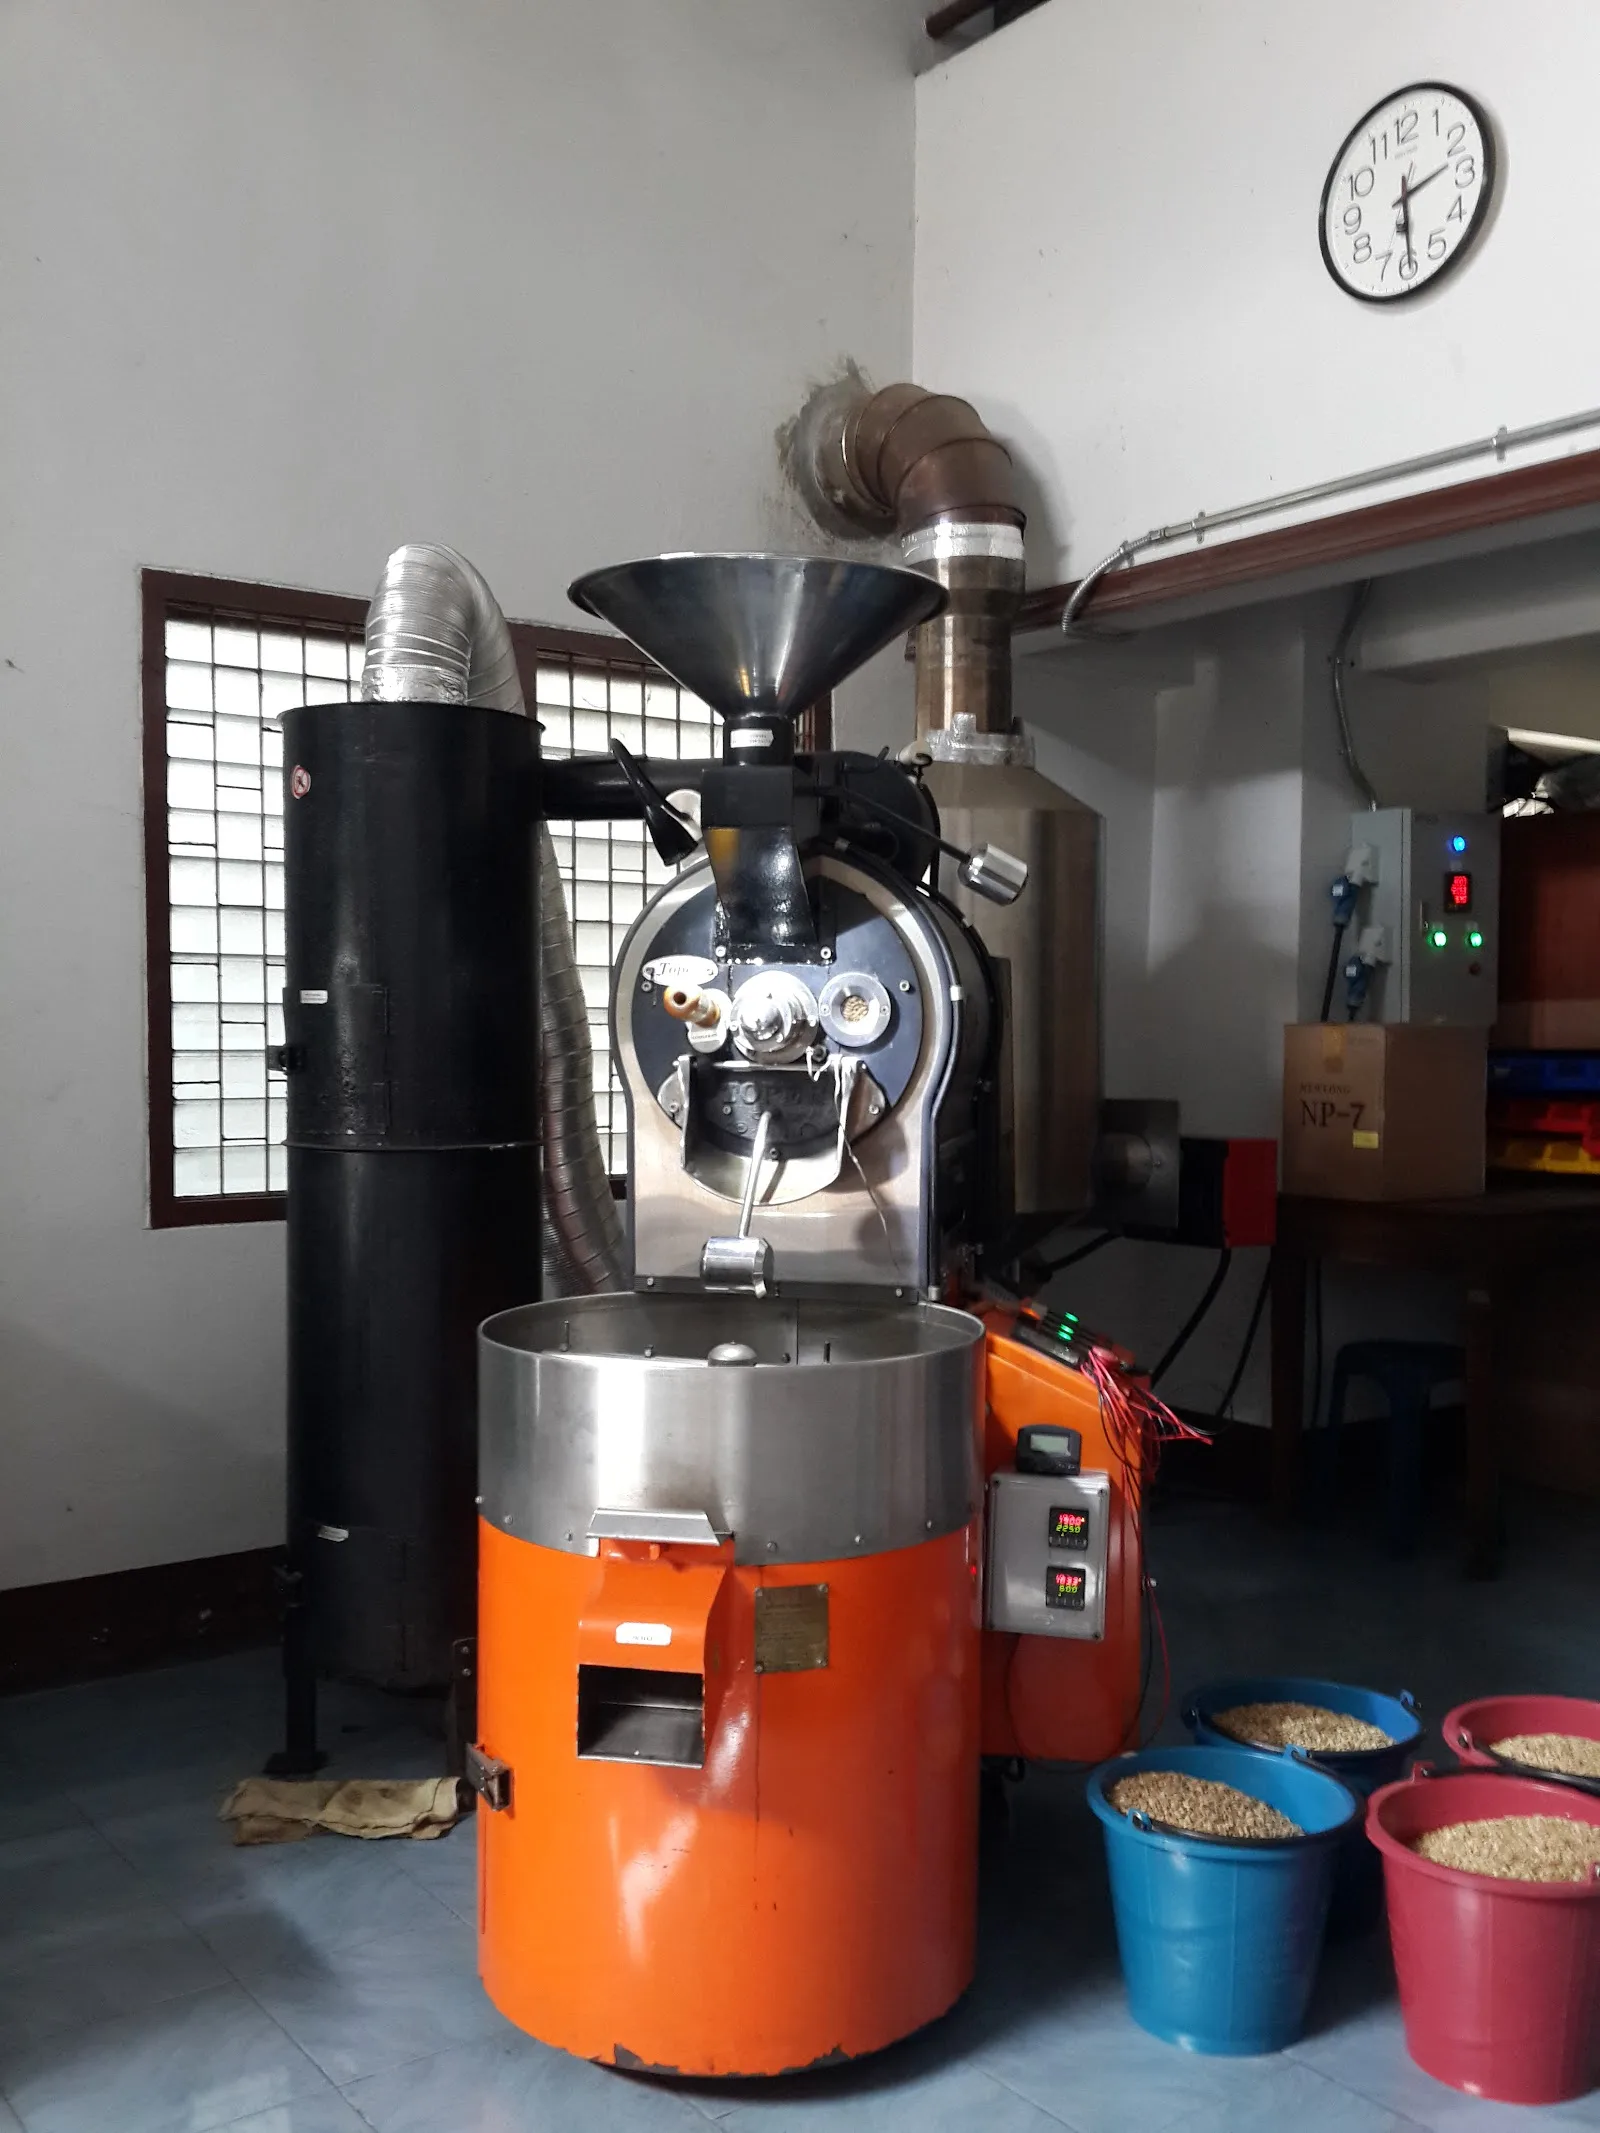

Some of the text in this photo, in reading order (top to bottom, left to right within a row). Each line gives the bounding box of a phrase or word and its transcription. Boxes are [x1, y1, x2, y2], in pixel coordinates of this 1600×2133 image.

[1394, 110, 1419, 146] 12
[1432, 108, 1440, 136] 1
[1369, 131, 1387, 165] 11
[1447, 122, 1466, 158] 2
[1349, 167, 1375, 201] 10
[1454, 154, 1475, 189] 3
[1343, 203, 1361, 236] 9
[1446, 193, 1467, 223] 4
[1352, 233, 1372, 264] 8
[1427, 228, 1447, 260] 5
[1375, 250, 1393, 282] 7
[1399, 248, 1418, 280] 6
[1300, 1100, 1366, 1130] NP-7
